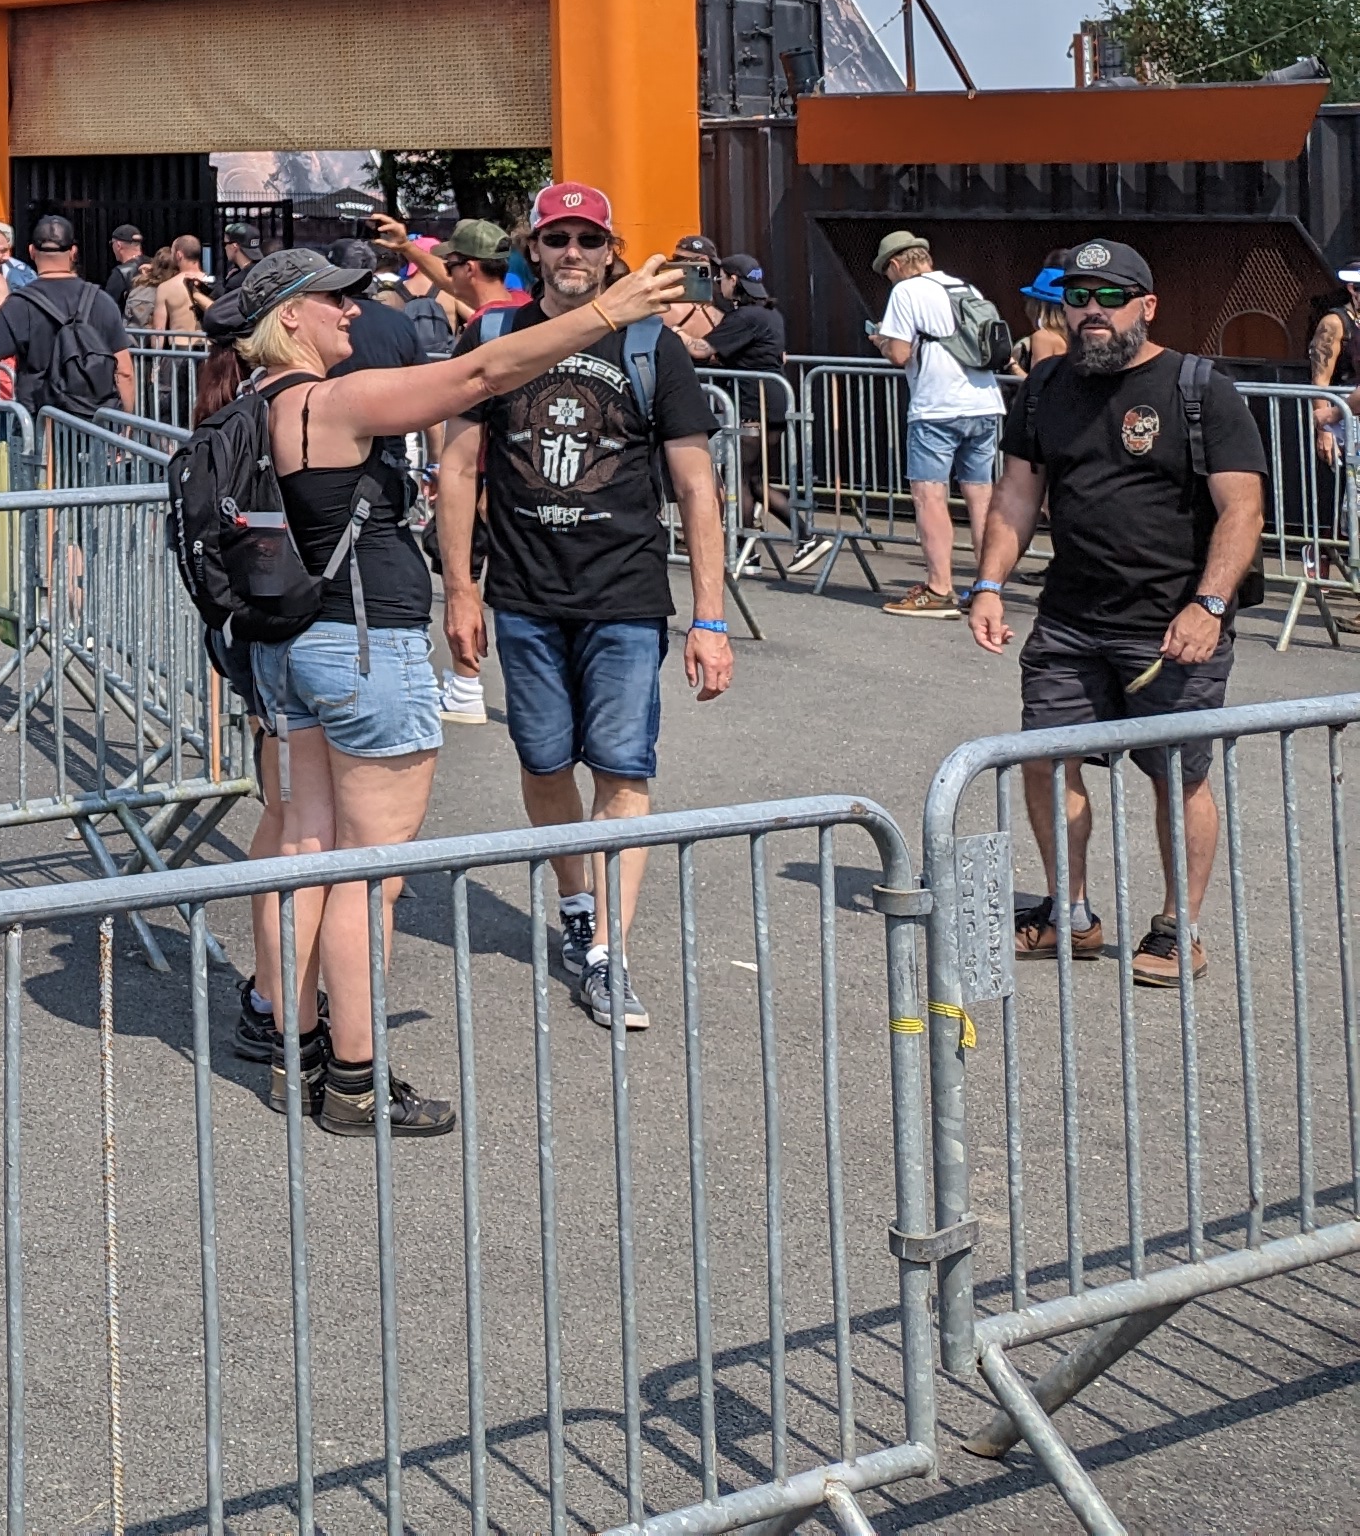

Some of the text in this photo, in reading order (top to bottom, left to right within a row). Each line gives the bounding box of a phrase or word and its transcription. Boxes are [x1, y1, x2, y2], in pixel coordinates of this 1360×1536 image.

[562, 192, 582, 208] W
[536, 504, 585, 527] HELLFEST
[193, 540, 204, 556] 20
